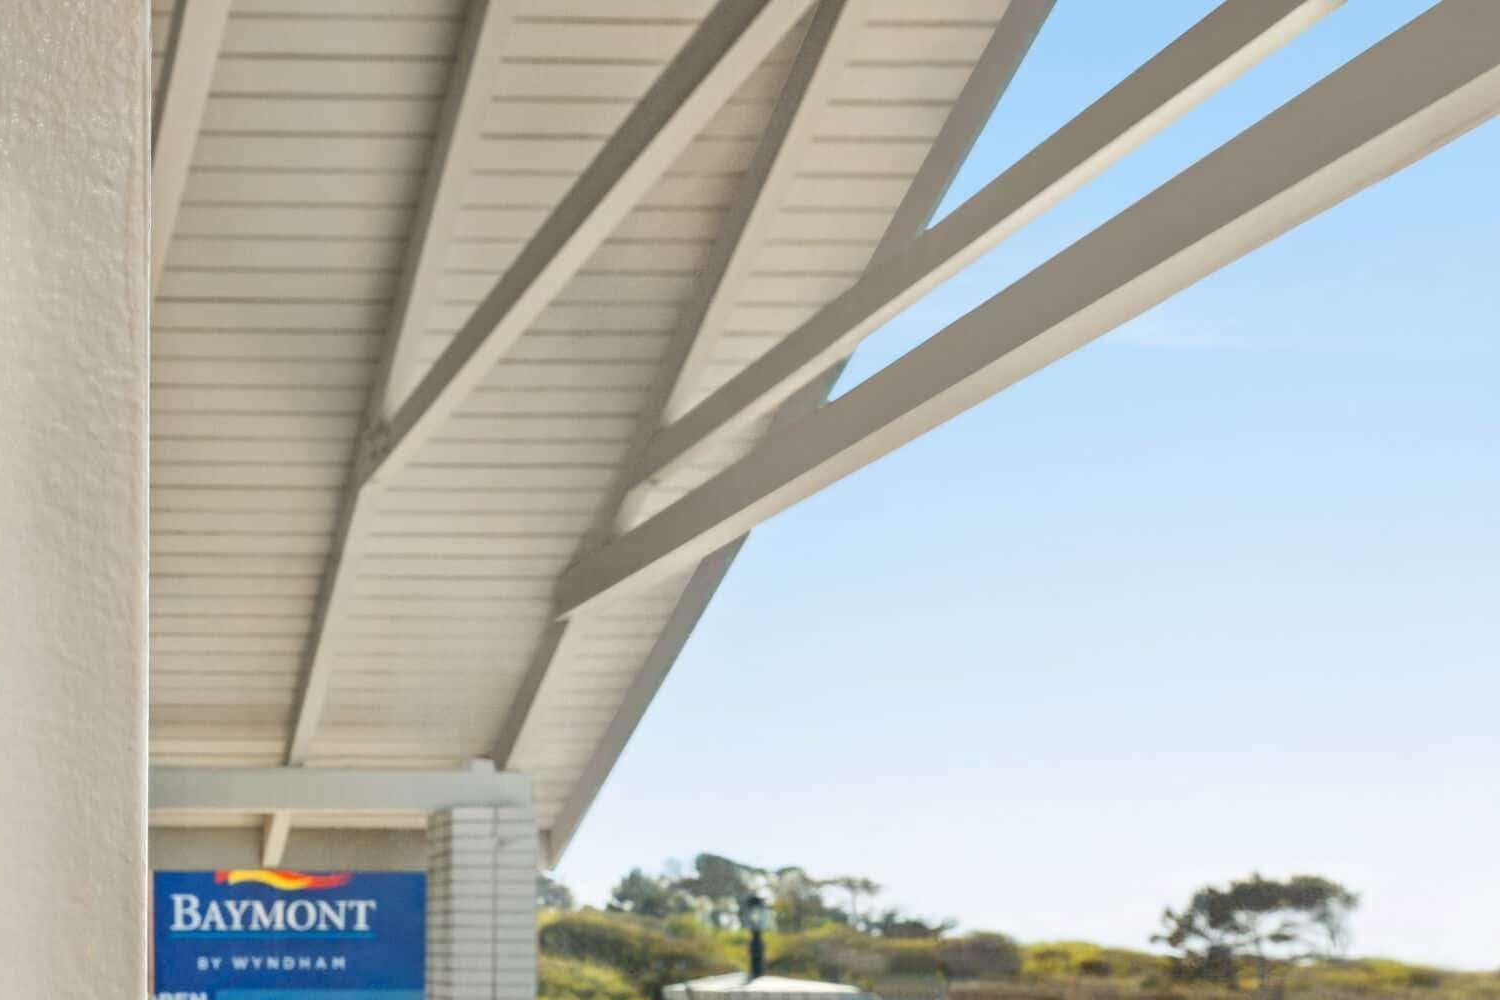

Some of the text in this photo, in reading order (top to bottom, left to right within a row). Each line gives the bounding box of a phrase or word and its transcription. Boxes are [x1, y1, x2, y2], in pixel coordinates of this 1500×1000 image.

[170, 893, 376, 932] BAYMONT
[197, 956, 347, 971] BY WYNDHAM
